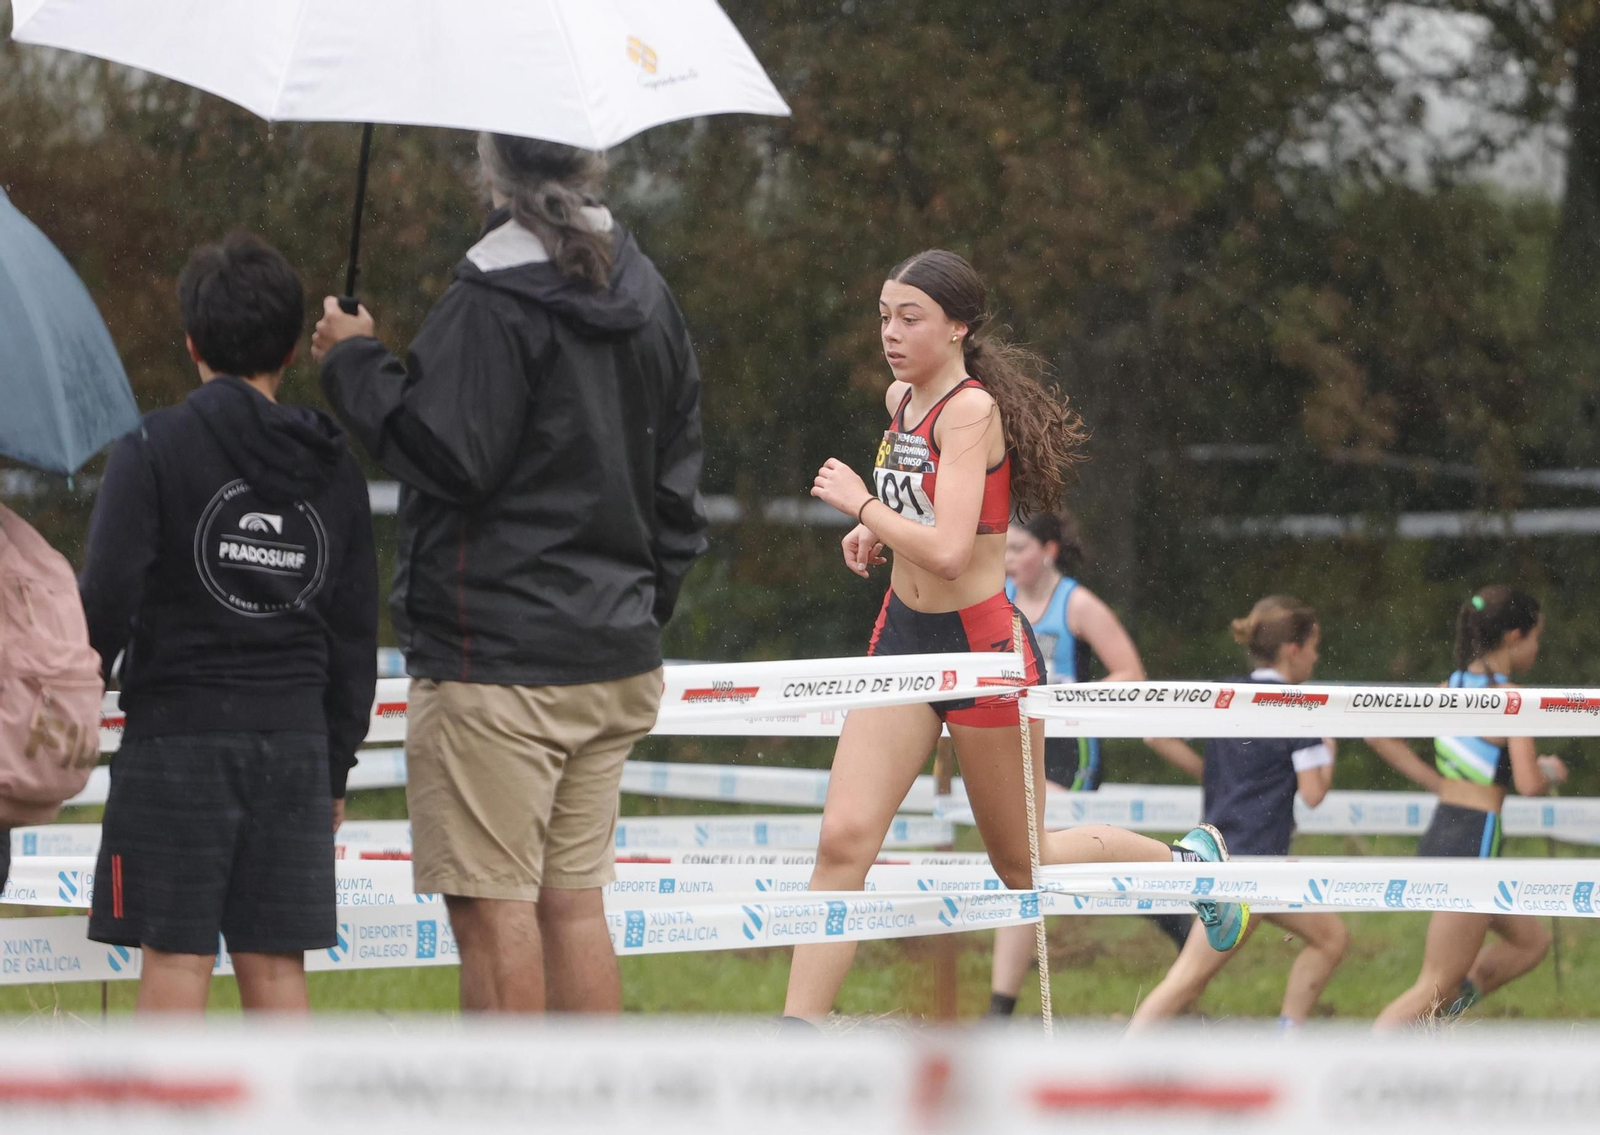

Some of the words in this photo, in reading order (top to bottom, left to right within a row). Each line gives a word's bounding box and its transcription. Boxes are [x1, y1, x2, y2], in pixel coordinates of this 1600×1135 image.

[218, 541, 306, 569] PRADOSURF
[783, 678, 866, 698] CONCELLO
[870, 677, 893, 693] DE
[899, 675, 936, 691] VIGO
[1053, 688, 1140, 702] CONCELLO
[1144, 688, 1168, 702] DE
[1174, 688, 1212, 703] VIGO
[1352, 692, 1434, 708] CONCELLO
[1438, 693, 1459, 709] DE
[1464, 693, 1501, 709] VIGO
[1584, 704, 1600, 717] xog
[335, 878, 373, 890] XUNTA
[613, 881, 657, 893] DEPORTE
[678, 881, 714, 893] XUNTA
[780, 881, 808, 891] DEPOR
[1142, 880, 1192, 892] DEPORTE
[1216, 881, 1258, 893] XUNTA
[1334, 882, 1385, 894] DEPORTE
[1408, 883, 1449, 895] XUNTA
[1523, 884, 1573, 896] DEPORTE
[0, 888, 38, 900] ALICIA
[352, 893, 395, 905] GALICIA
[774, 903, 826, 918] DEPORTE
[851, 900, 894, 915] XUNTA
[1428, 897, 1476, 910] GALICIA
[1523, 900, 1568, 911] GALEGO
[649, 910, 694, 926] XUNTA
[847, 917, 865, 931] DE
[867, 913, 917, 930] GALICIA
[359, 923, 413, 940] DEPORTE
[647, 929, 664, 944] DE
[667, 926, 718, 942] GALICIA
[772, 921, 817, 936] GALEGO
[4, 938, 53, 956] XUNTA
[359, 943, 408, 959] GALEGO
[3, 957, 21, 974] DE
[25, 956, 82, 973] GALICIA
